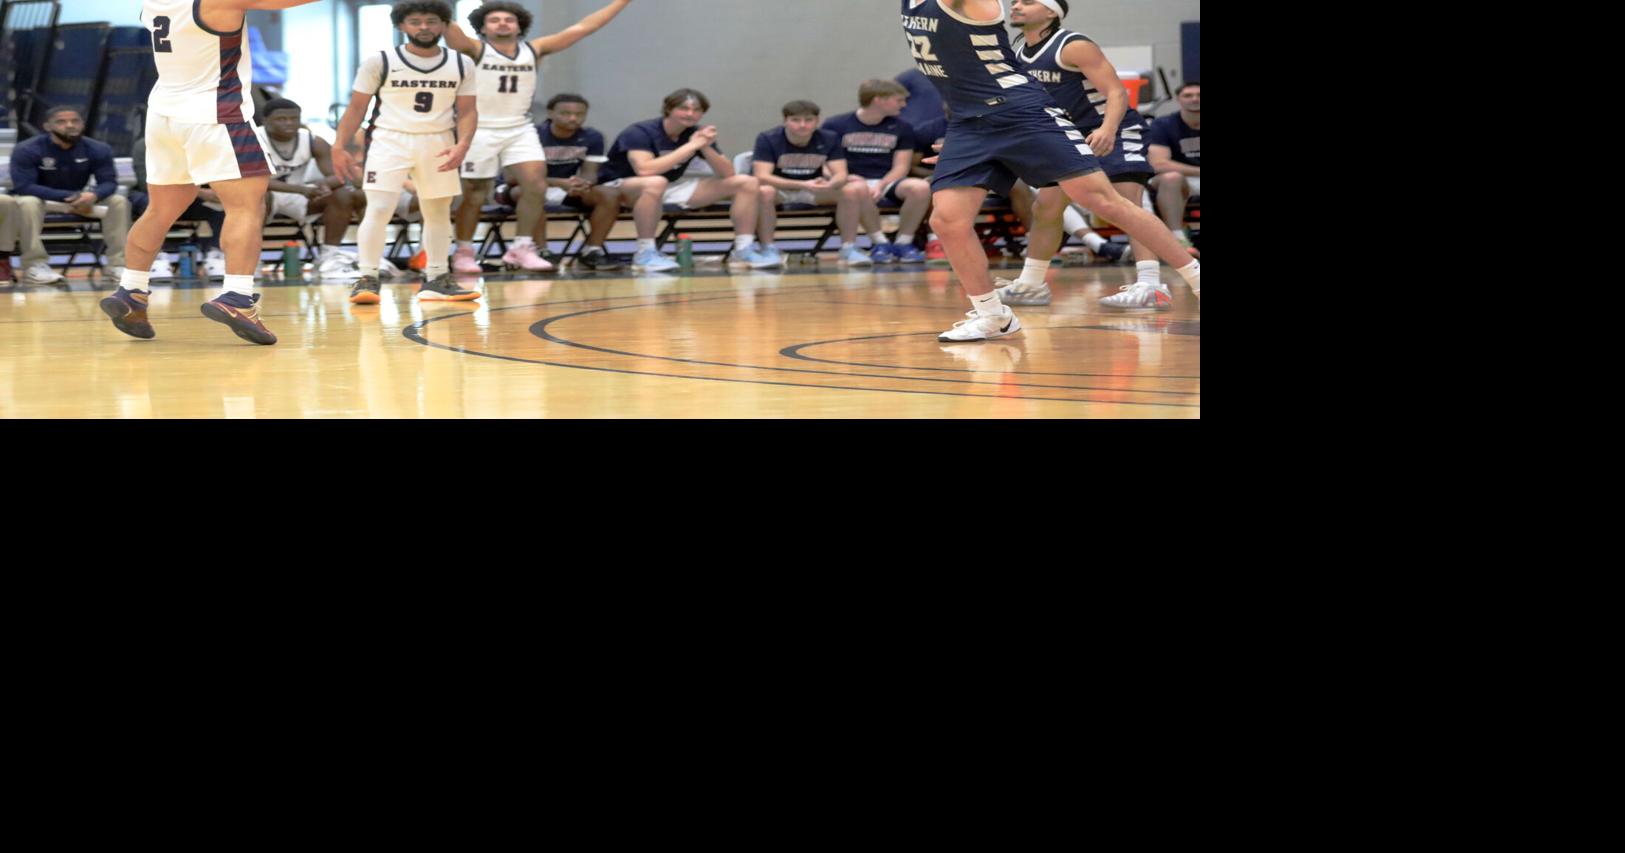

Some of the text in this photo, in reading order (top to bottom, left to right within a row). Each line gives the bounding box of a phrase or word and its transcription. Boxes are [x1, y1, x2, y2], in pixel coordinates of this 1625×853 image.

[153, 15, 172, 53] 2
[482, 63, 533, 72] EASTERN
[390, 80, 457, 88] EASTERN
[497, 75, 518, 93] 11
[413, 91, 434, 113] 9
[465, 162, 474, 172] E
[367, 171, 376, 183] E
